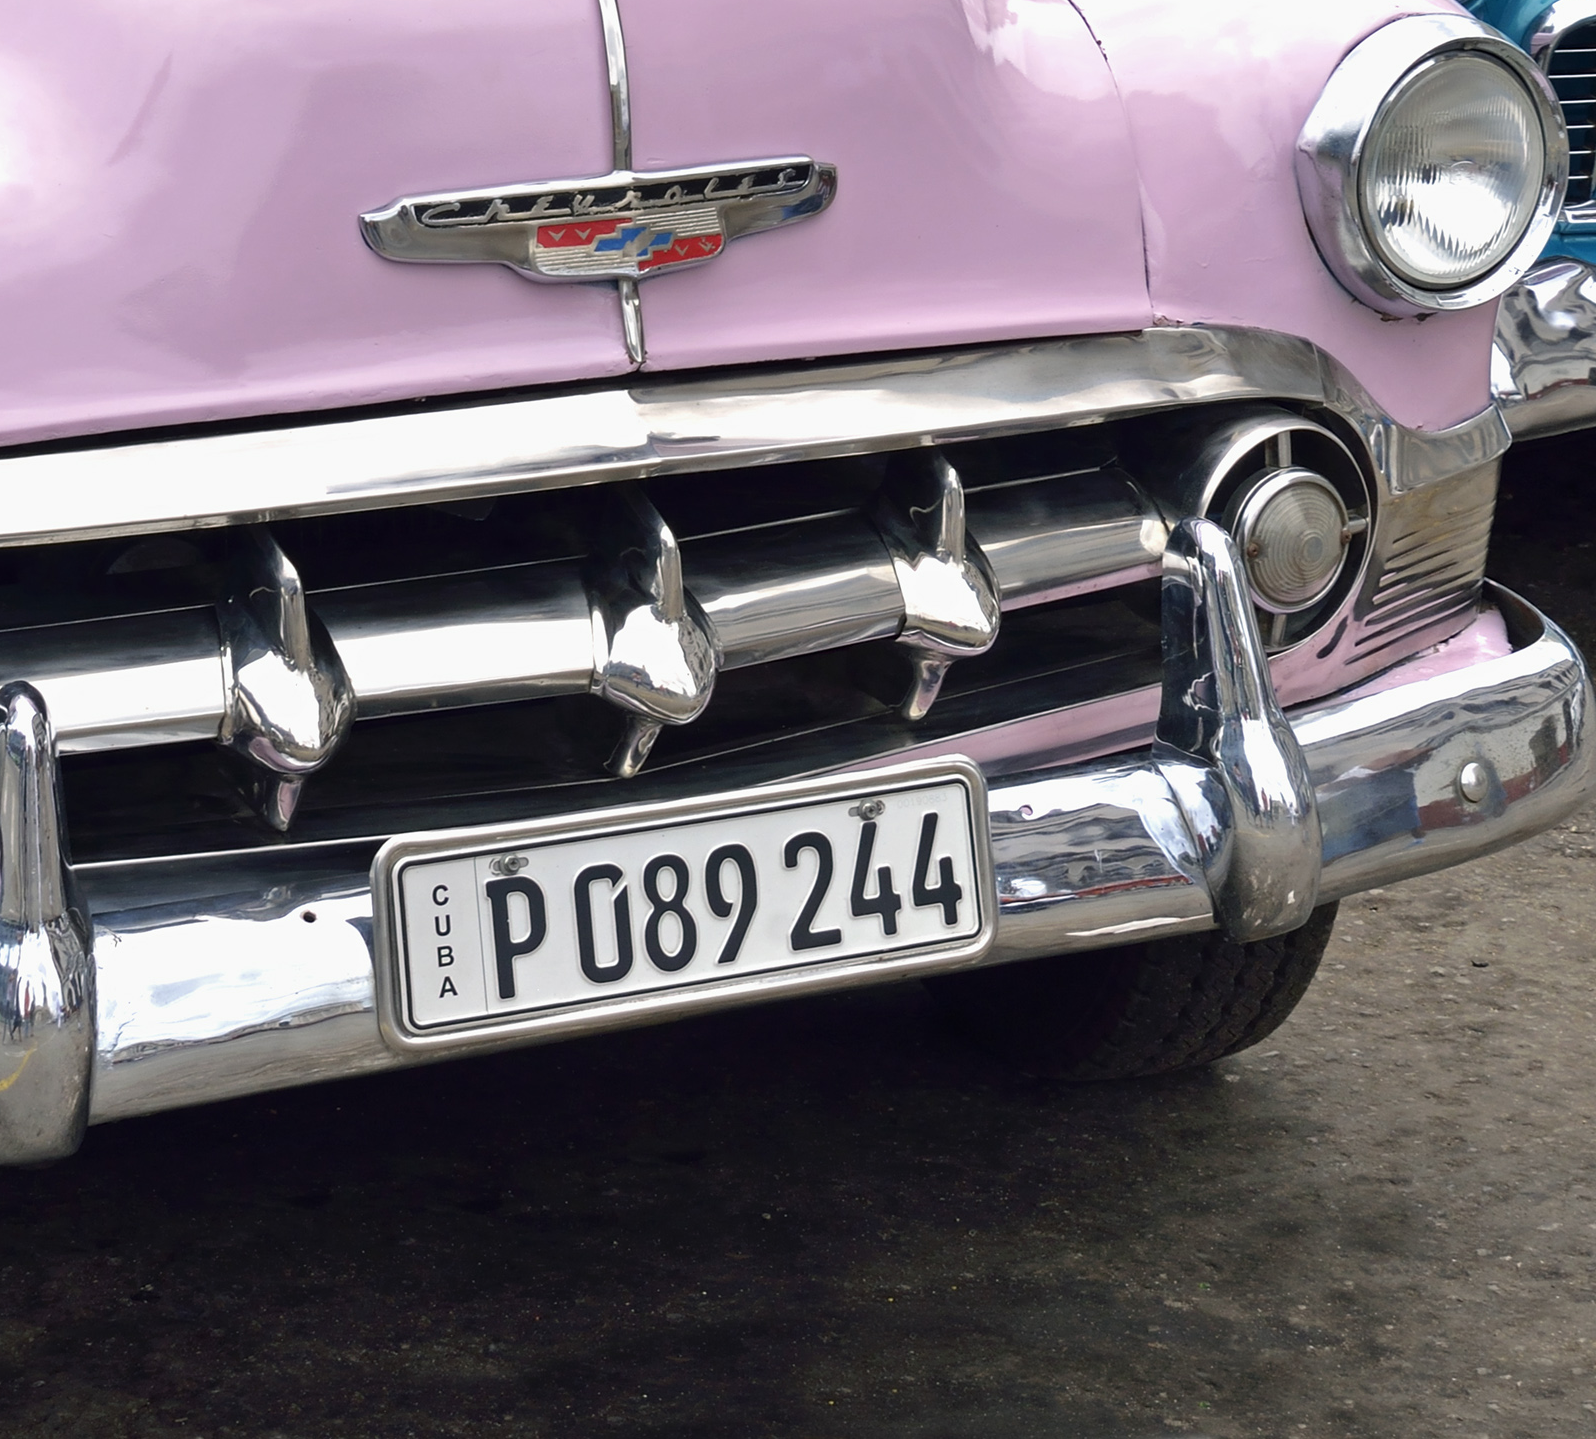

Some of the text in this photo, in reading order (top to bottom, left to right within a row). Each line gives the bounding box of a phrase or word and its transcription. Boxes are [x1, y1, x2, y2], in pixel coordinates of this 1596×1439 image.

[432, 884, 458, 999] CUBA
[485, 812, 963, 1000] P 089 244
